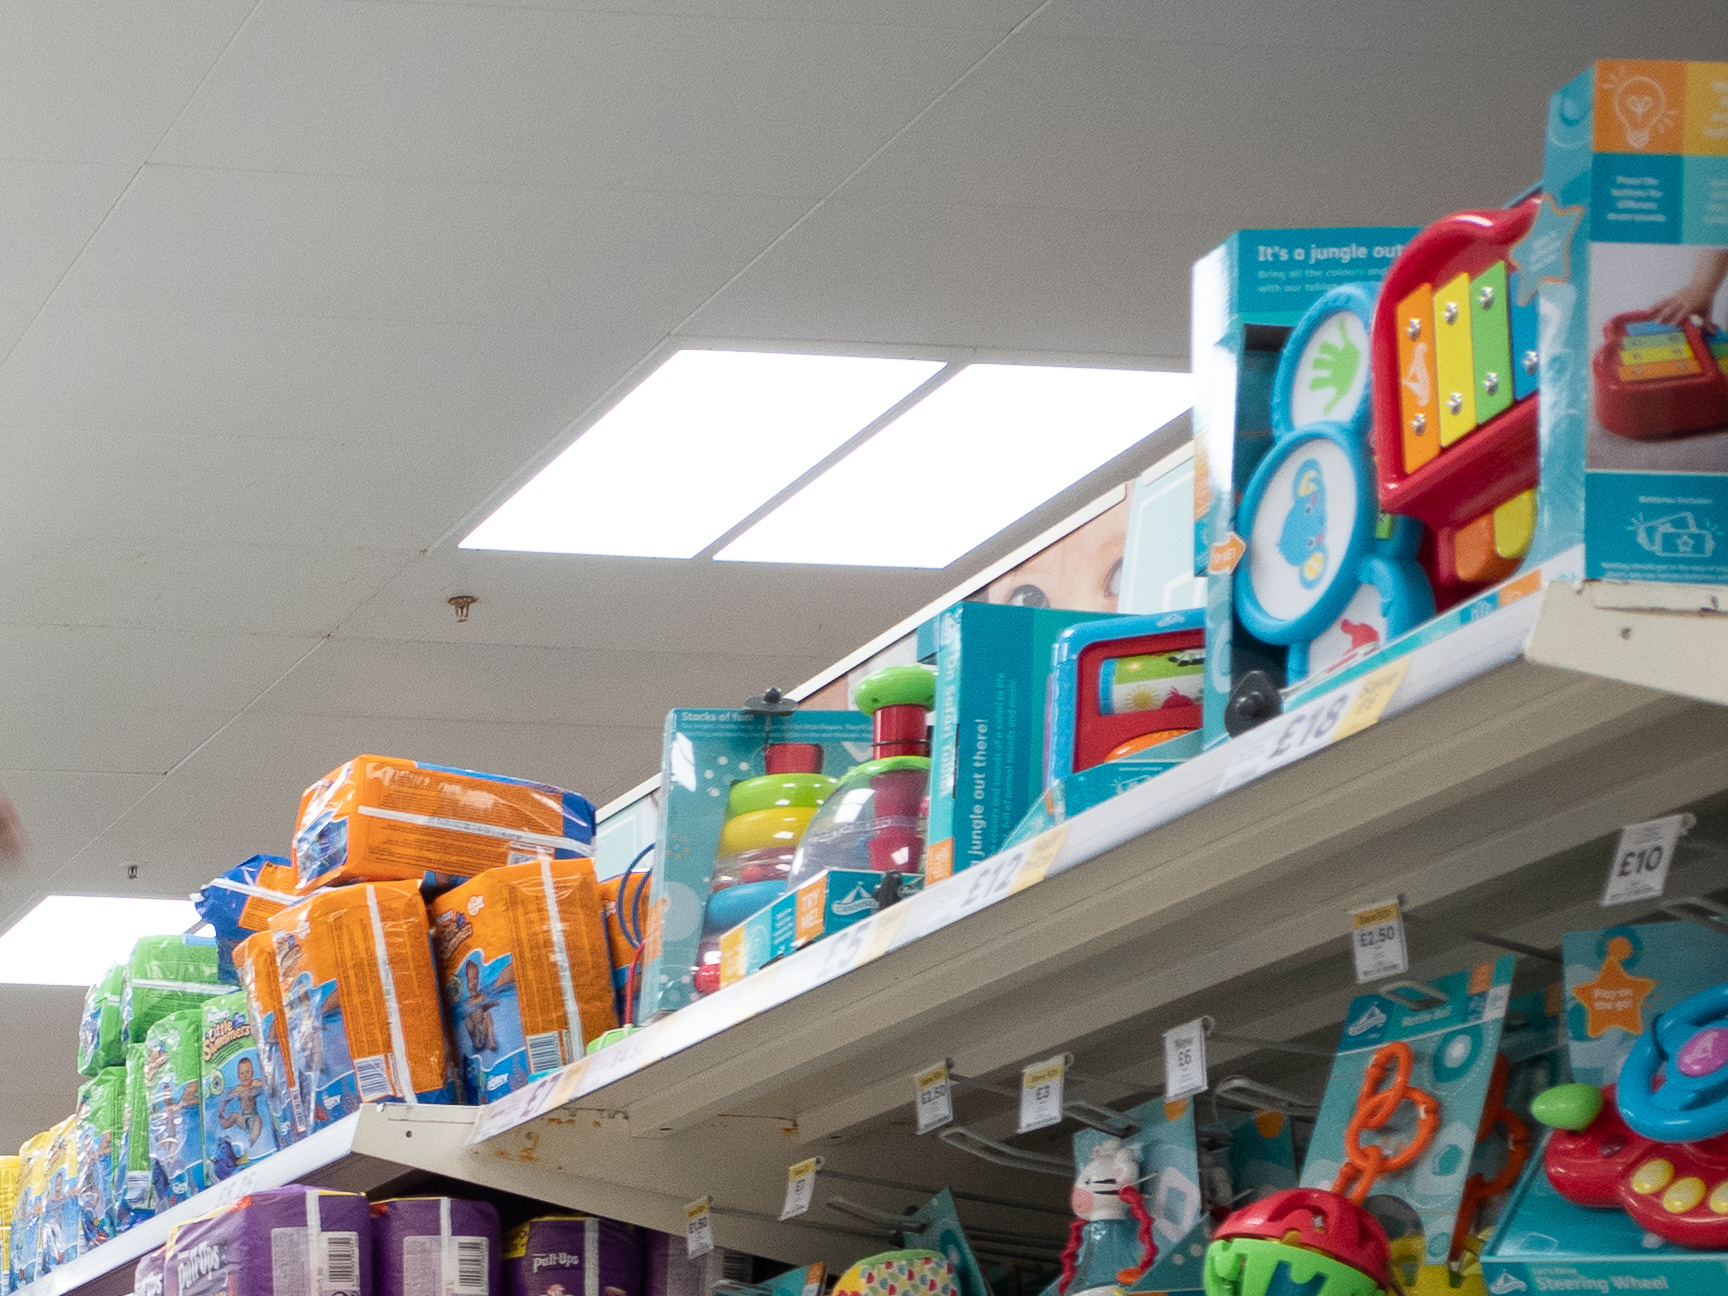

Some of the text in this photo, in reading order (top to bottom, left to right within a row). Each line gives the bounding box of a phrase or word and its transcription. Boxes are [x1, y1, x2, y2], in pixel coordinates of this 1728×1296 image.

[1257, 245, 1289, 262] It's
[1293, 249, 1306, 261] a
[1310, 243, 1369, 264] jungle
[969, 718, 989, 857] jungle out there!
[1617, 845, 1664, 878] £10
[1359, 926, 1396, 948] £2.50
[207, 1018, 237, 1042] Little
[177, 1240, 221, 1291] Pull-Ups
[532, 1250, 580, 1273] Pull-Ups
